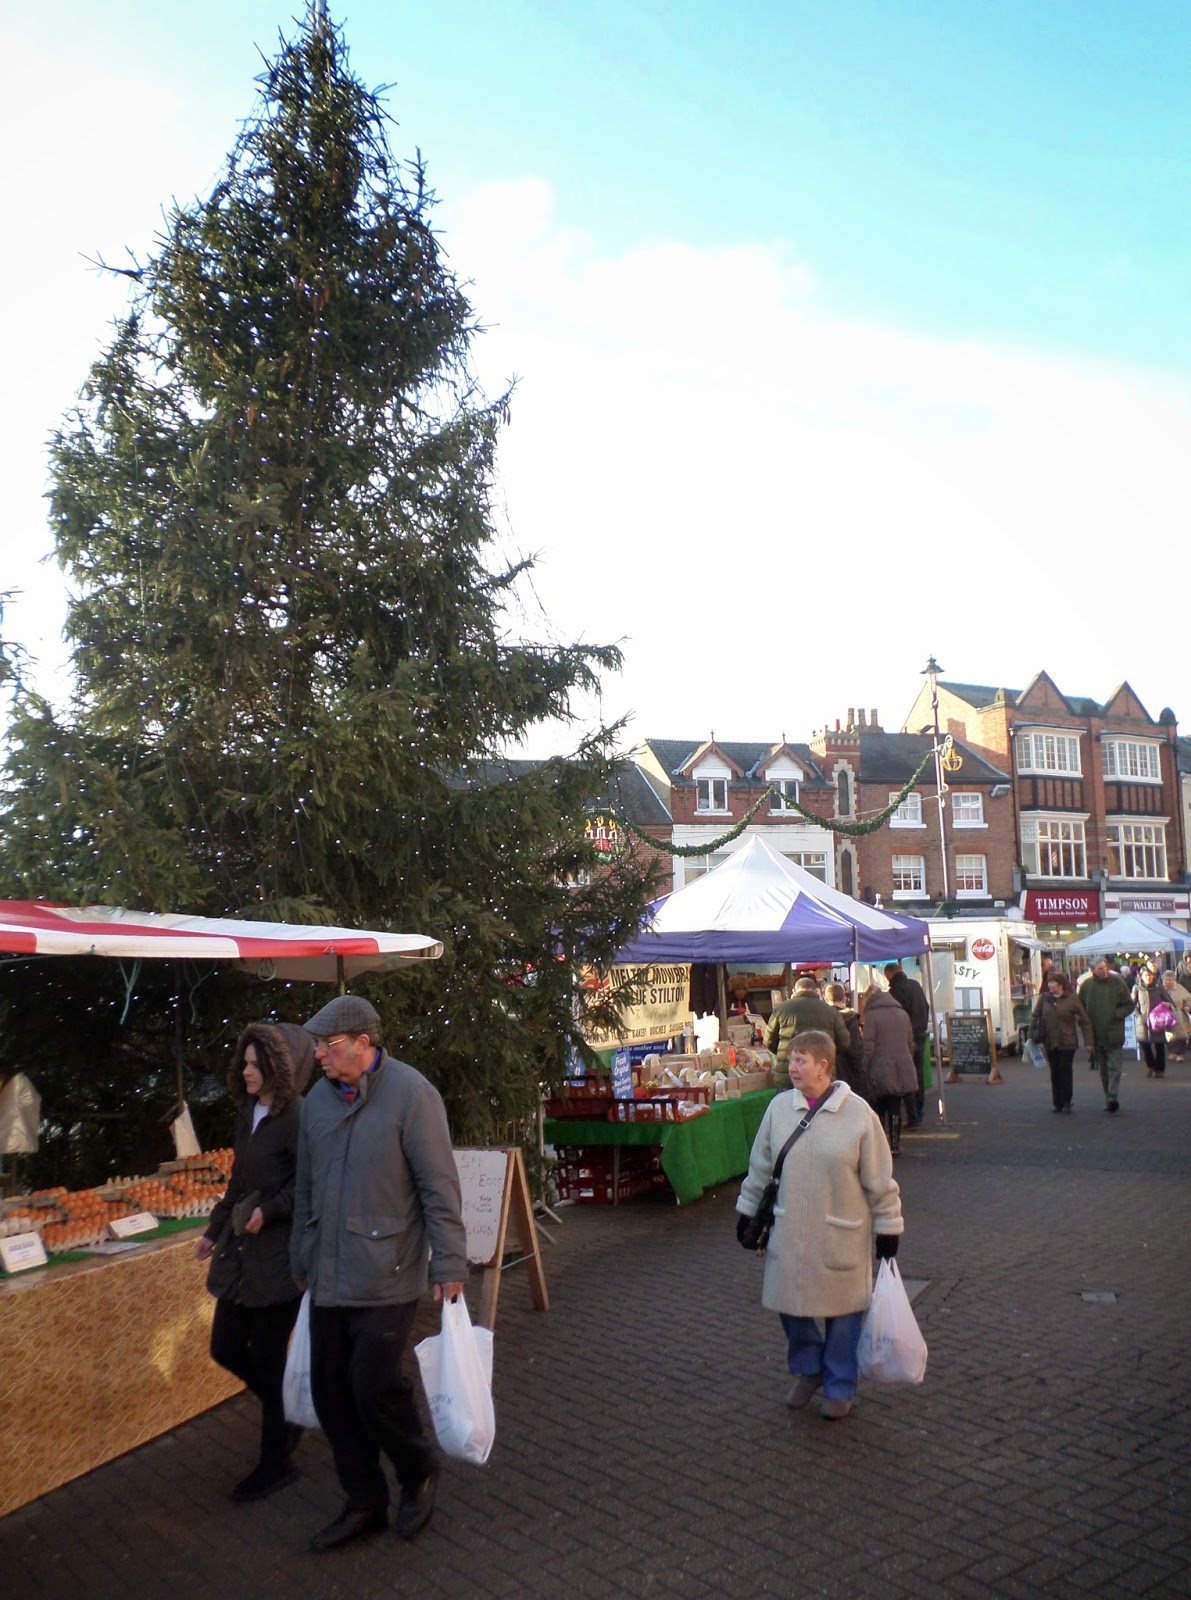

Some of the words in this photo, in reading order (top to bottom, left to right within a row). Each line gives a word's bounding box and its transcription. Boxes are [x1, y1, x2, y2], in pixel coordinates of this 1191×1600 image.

[1035, 898, 1088, 910] TIMPSON
[1133, 901, 1161, 910] WALKER
[650, 986, 685, 1004] STILTON
